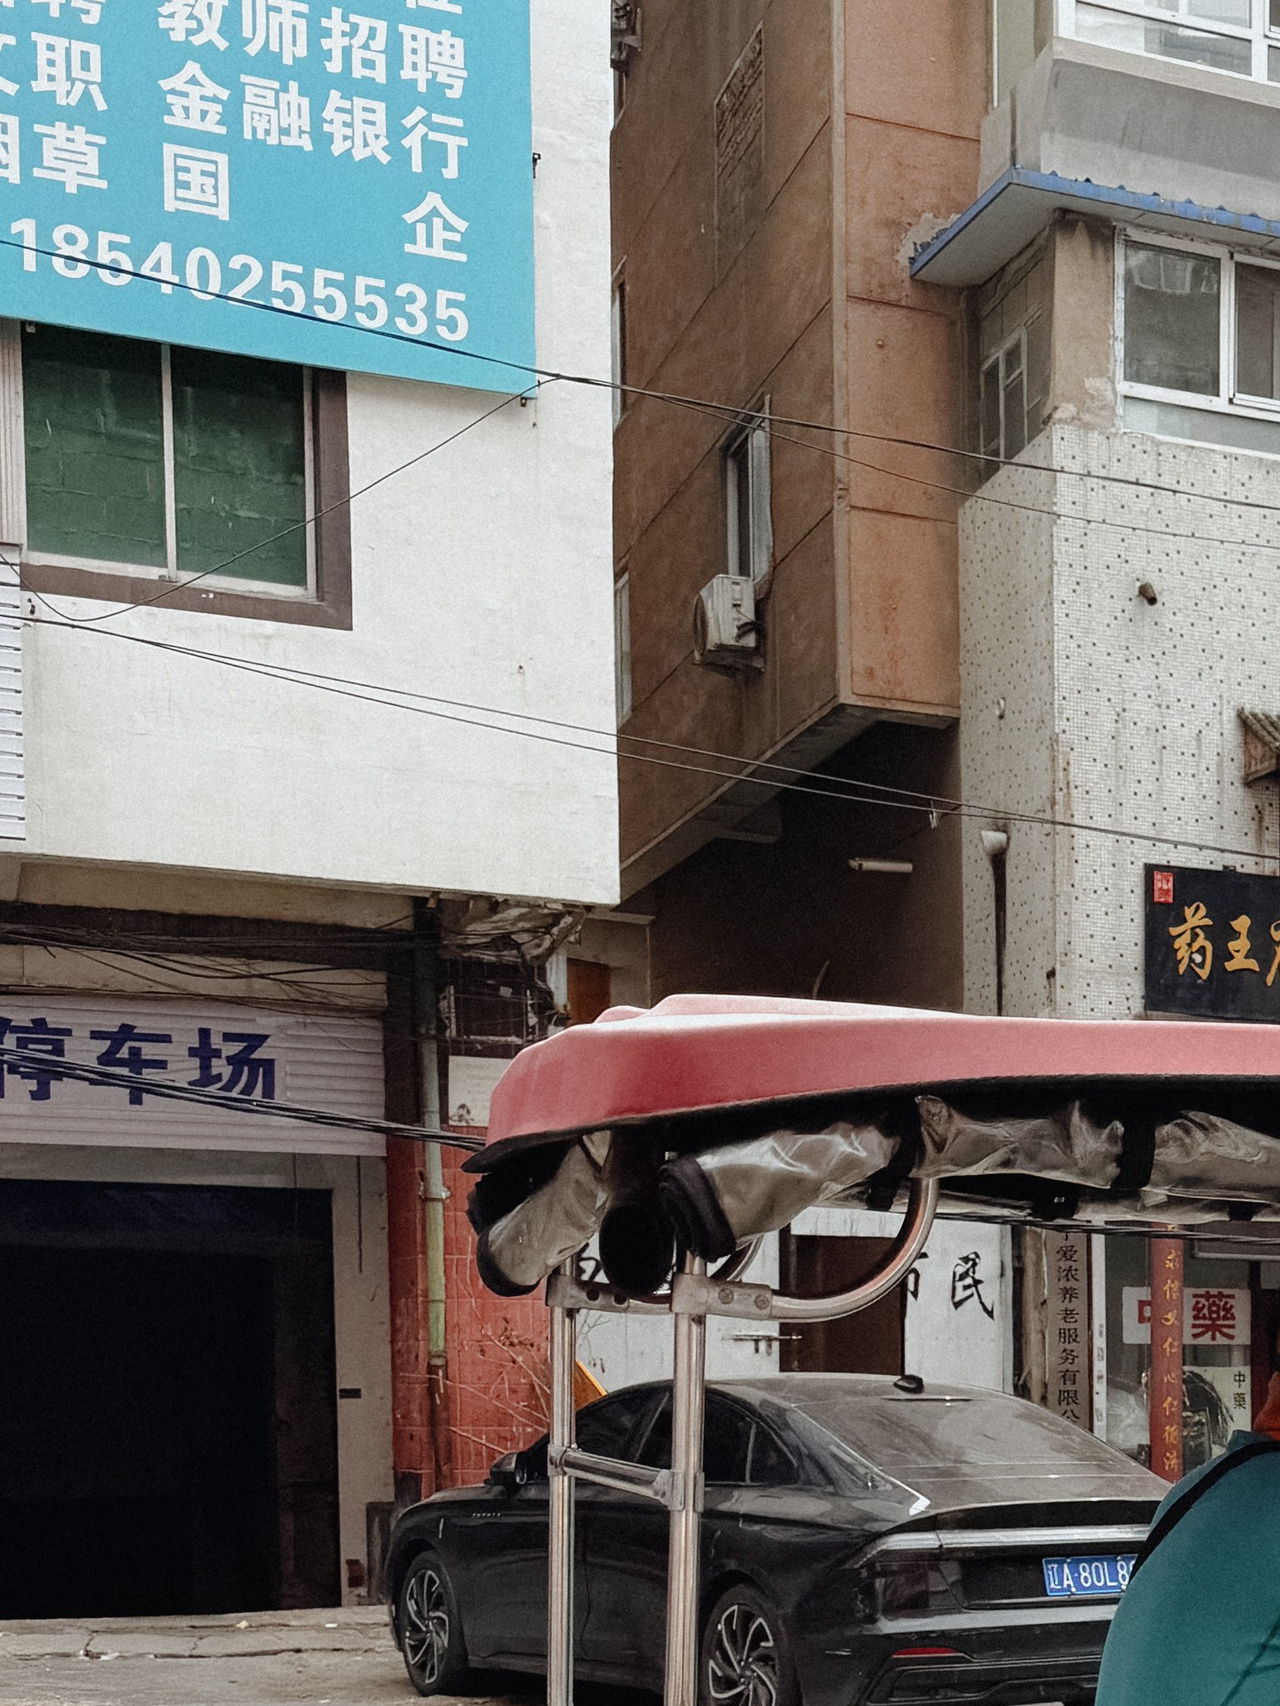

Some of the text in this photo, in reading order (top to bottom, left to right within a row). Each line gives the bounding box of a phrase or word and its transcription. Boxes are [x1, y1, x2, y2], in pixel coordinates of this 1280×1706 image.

[157, 0, 468, 99] 教师招聘
[157, 60, 469, 179] 金融银行
[10, 217, 469, 342] 18540255535
[0, 1017, 276, 1105] 停车场
